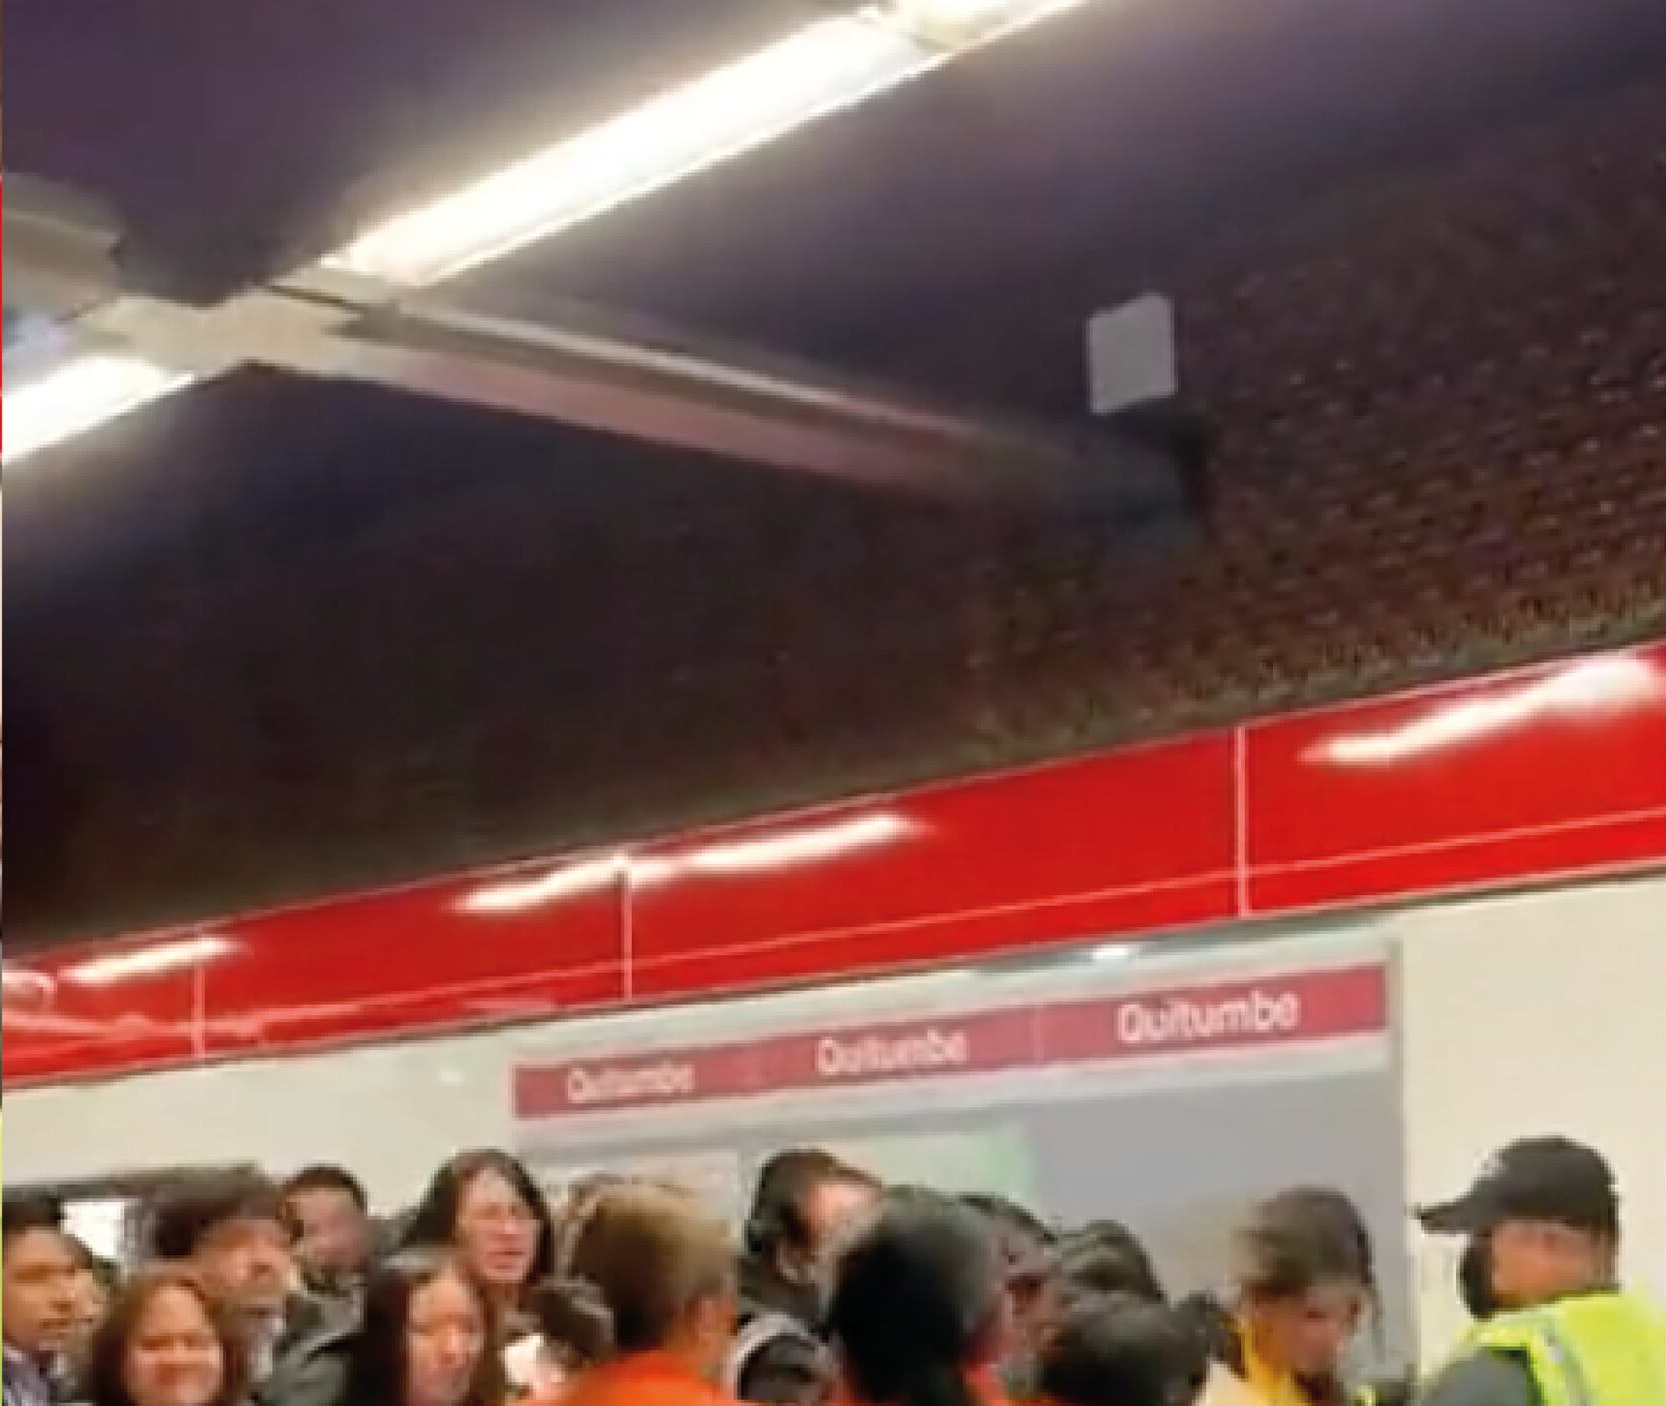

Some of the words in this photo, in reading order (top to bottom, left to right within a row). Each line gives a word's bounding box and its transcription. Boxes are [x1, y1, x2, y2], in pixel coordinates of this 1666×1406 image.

[1116, 986, 1303, 1044] Quitumbe
[815, 1026, 969, 1077] Quitumbe
[565, 1060, 697, 1104] Quitumbe
